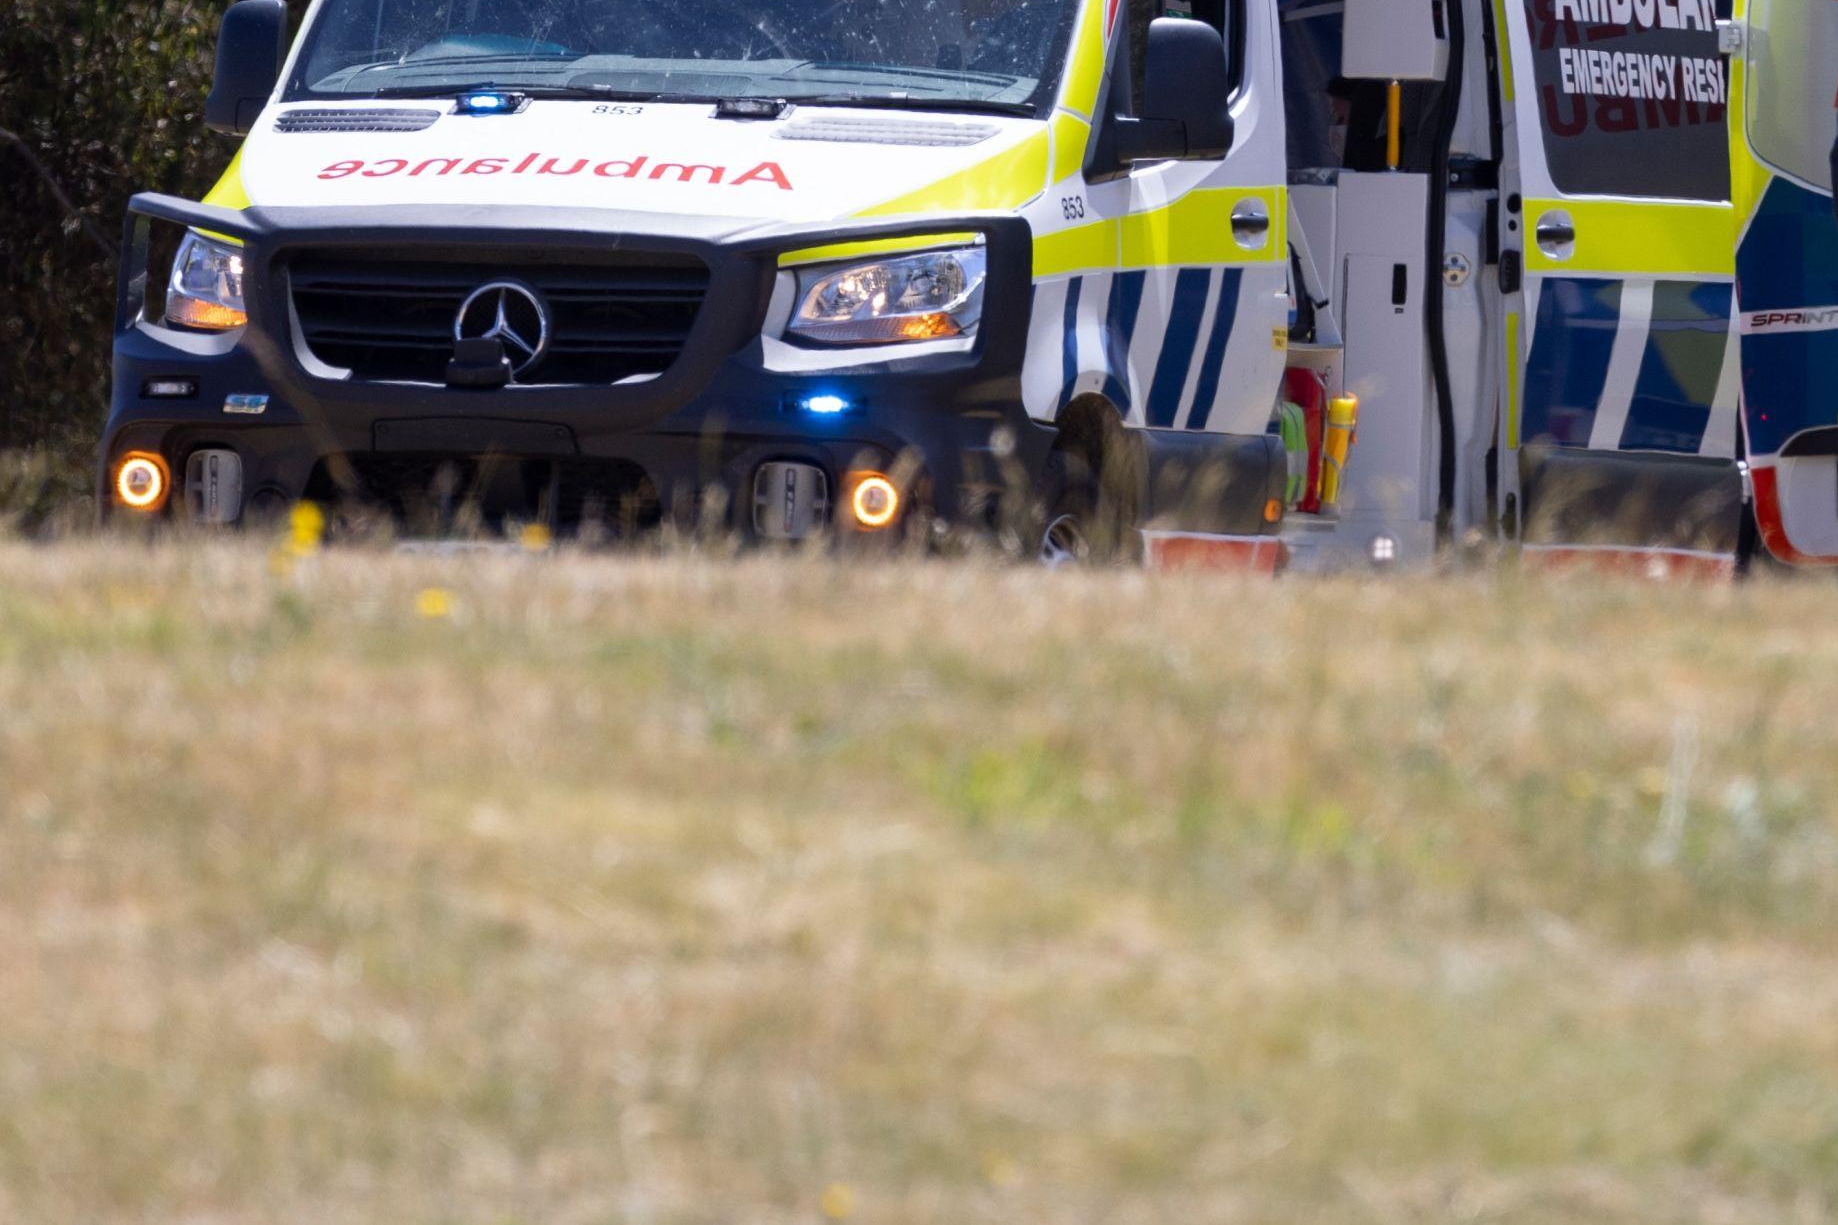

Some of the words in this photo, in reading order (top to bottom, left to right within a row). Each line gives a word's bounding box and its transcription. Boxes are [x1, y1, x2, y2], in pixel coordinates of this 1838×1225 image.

[1558, 47, 1677, 101] EMERGENCY
[591, 104, 643, 115] 853
[1061, 195, 1085, 220] 853
